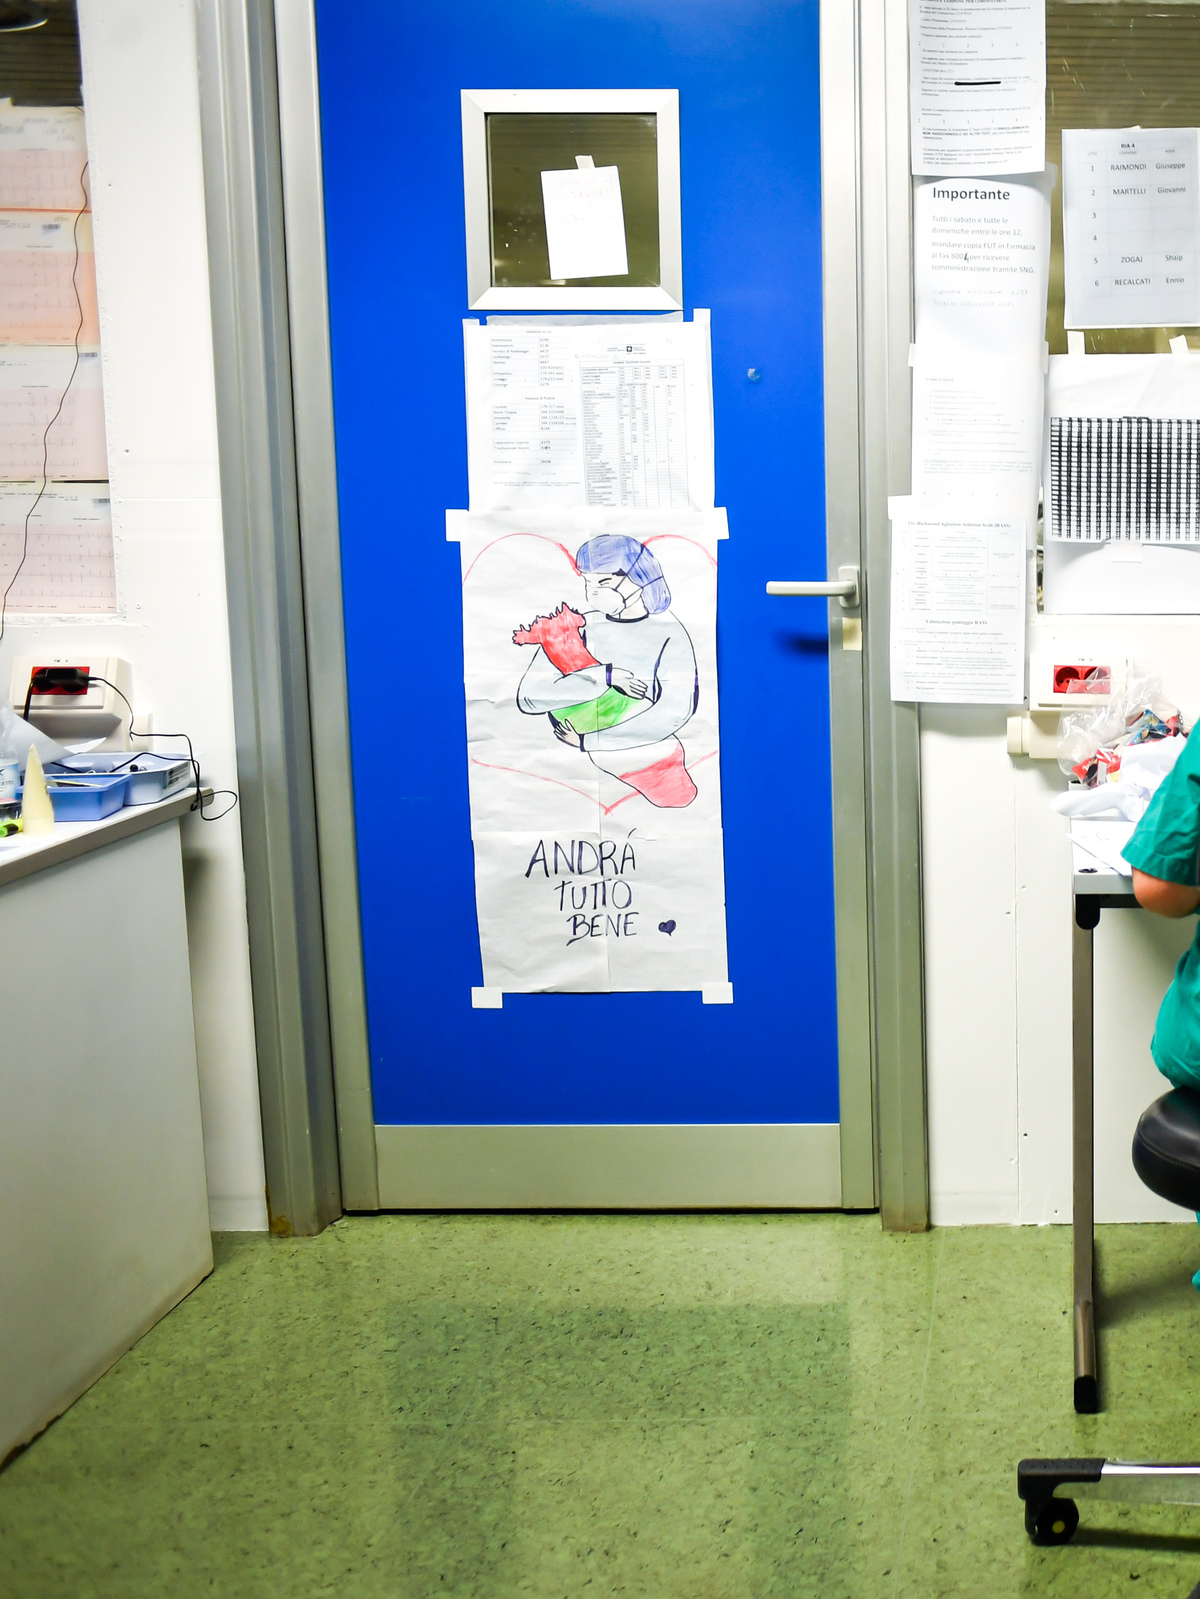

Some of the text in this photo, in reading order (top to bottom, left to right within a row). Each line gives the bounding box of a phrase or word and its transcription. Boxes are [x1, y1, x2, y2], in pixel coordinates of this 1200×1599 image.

[1110, 163, 1147, 171] RAIMONDI
[1155, 162, 1186, 170] Giuseppe
[933, 187, 1010, 201] Importante
[1157, 186, 1186, 194] Giovanni
[932, 215, 948, 223] Tutti
[953, 215, 977, 223] sabato
[931, 227, 970, 235] domeniche
[963, 242, 982, 250] copia
[1006, 243, 1036, 251] farmacia
[969, 254, 981, 262] per
[931, 264, 991, 272] somministrazione
[992, 265, 1018, 273] tramite
[1115, 278, 1151, 286] RECALCATI
[1166, 276, 1185, 284] Ennio
[553, 877, 633, 912] TUTTO
[565, 911, 640, 947] BENE
